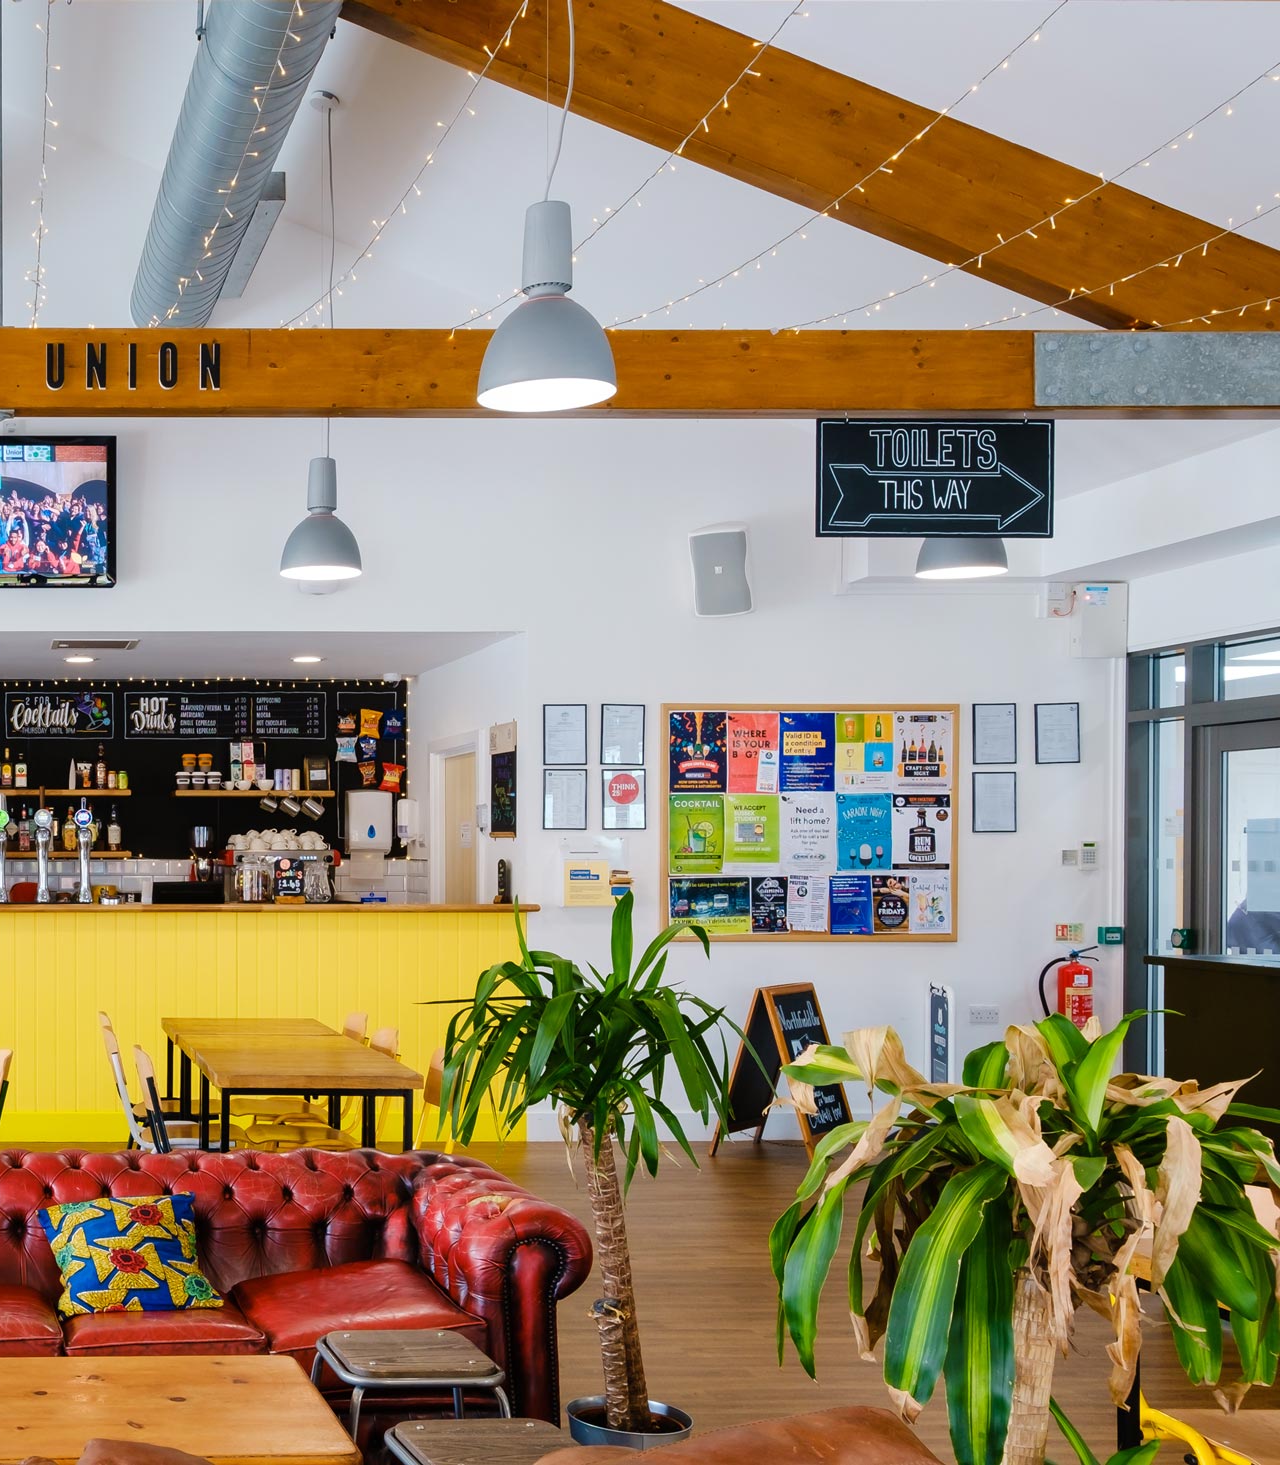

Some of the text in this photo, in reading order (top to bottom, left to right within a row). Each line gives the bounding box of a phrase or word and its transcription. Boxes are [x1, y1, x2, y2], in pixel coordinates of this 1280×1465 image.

[45, 342, 221, 391] UNION
[869, 428, 998, 470] TOILETS
[878, 479, 972, 510] THIS WAY
[25, 697, 30, 705] 2
[55, 696, 59, 704] 1
[140, 697, 169, 712] HOT
[10, 702, 79, 731] Cocktails
[130, 710, 177, 732] Drinks
[732, 730, 767, 738] WHERE
[732, 740, 771, 748] IS YOUR
[674, 800, 721, 808] COCKTAIL
[795, 806, 818, 814] Need
[842, 806, 887, 820] KARAOKE NIGHT
[914, 836, 931, 845] RUM
